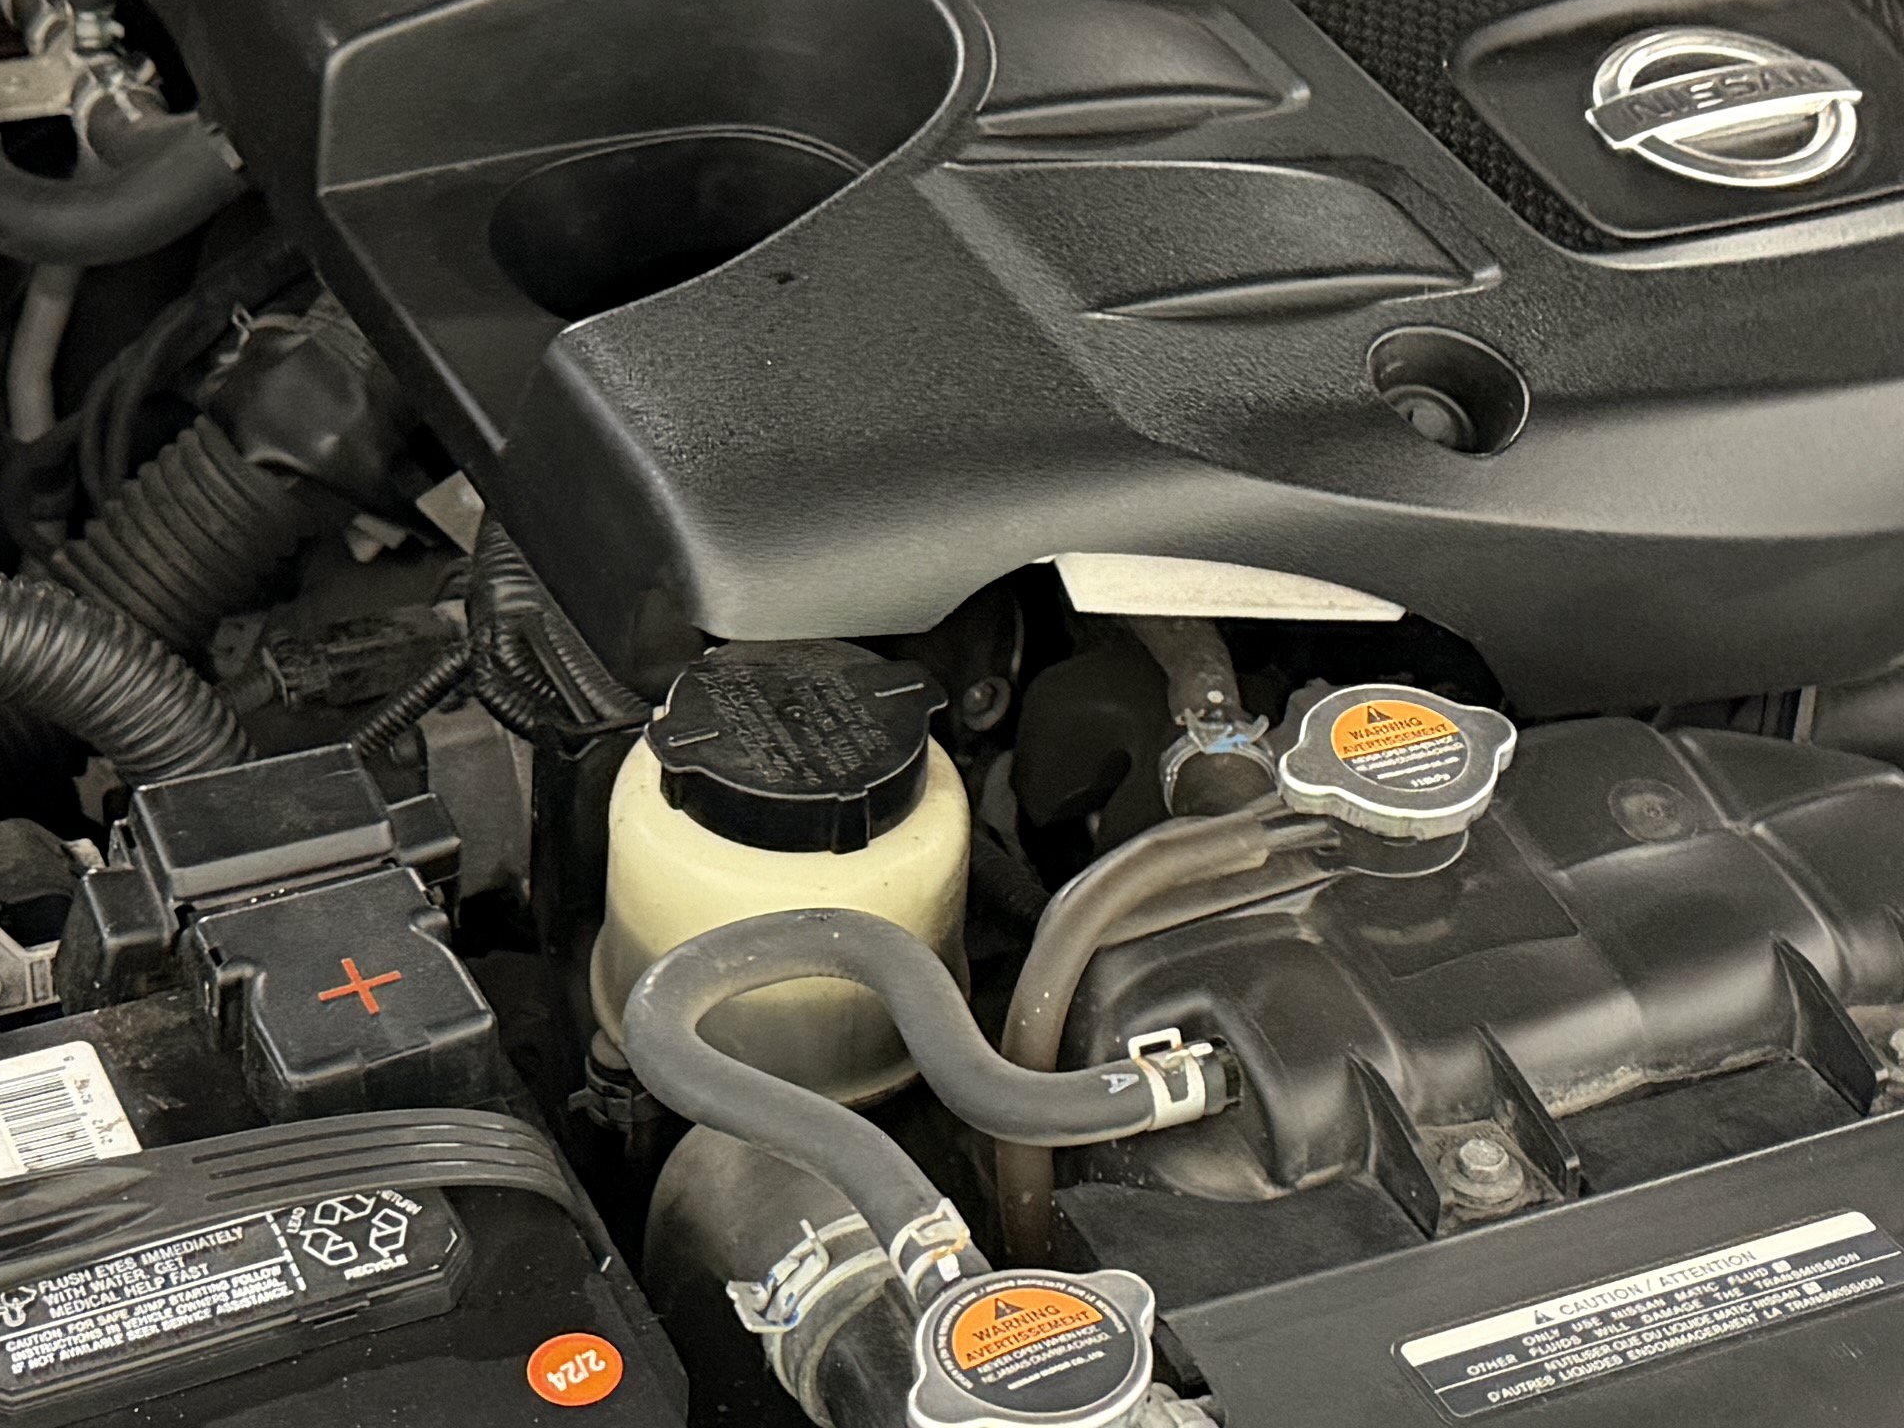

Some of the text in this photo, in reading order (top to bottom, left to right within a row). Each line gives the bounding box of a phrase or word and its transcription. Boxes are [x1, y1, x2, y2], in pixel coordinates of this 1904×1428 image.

[1622, 67, 1829, 121] NISSAN
[1343, 723, 1448, 756] AVERTISSEMENT
[1349, 717, 1422, 741] WARNING
[1100, 1073, 1139, 1094] A
[38, 1227, 244, 1296] FLUSH EYES IMMEDIATELY
[45, 1283, 88, 1307] WITH
[153, 1257, 188, 1277] GET
[344, 1254, 409, 1281] RECYCLE
[1560, 1283, 1642, 1316] CAUTION
[1659, 1250, 1757, 1288] ATTENTION
[49, 1262, 211, 1319] MEDICAL HELP FAST
[66, 1320, 94, 1335] FOR
[96, 1309, 131, 1326] SAFE
[133, 1299, 166, 1317] JUMP
[168, 1279, 230, 1307] STARTING
[231, 1265, 282, 1288] FOLLOW
[1466, 1251, 1861, 1377] OTHER FLUIDS WILL DAMAGE THE TRANSMISSION
[1521, 1327, 1561, 1348] ONLY
[1571, 1315, 1603, 1333] USE
[1611, 1297, 1666, 1322] NISSAN
[1674, 1281, 1719, 1302] MATIC
[1726, 1267, 1769, 1287] FLUID
[11, 1329, 104, 1363] INSTRUCTIONS
[106, 1322, 122, 1335] IN
[122, 1308, 173, 1331] VEHICLE
[28, 1352, 57, 1370] NOT
[59, 1333, 125, 1361] AVAILABLE
[125, 1324, 161, 1343] SEEK
[162, 1309, 213, 1333] SERVICE
[965, 1310, 1091, 1362] AVERTISSEMENT
[973, 1304, 1061, 1342] WARNING
[1559, 1353, 1624, 1382] LIQUIDES
[1626, 1313, 1760, 1360] ENDOMMAGERAIENT
[1762, 1307, 1783, 1320] LA
[1785, 1275, 1885, 1312] TRANSMISSION
[1613, 1335, 1642, 1351] QUE
[1642, 1329, 1663, 1343] DU
[1665, 1312, 1713, 1337] LIQUIDE
[1713, 1299, 1752, 1321] MATIC
[1752, 1288, 1801, 1310] NISSAN
[546, 1349, 607, 1391] 2/24
[977, 1353, 1013, 1374] NEVER
[1013, 1342, 1043, 1359] OPEN
[1042, 1331, 1078, 1349] WHEN
